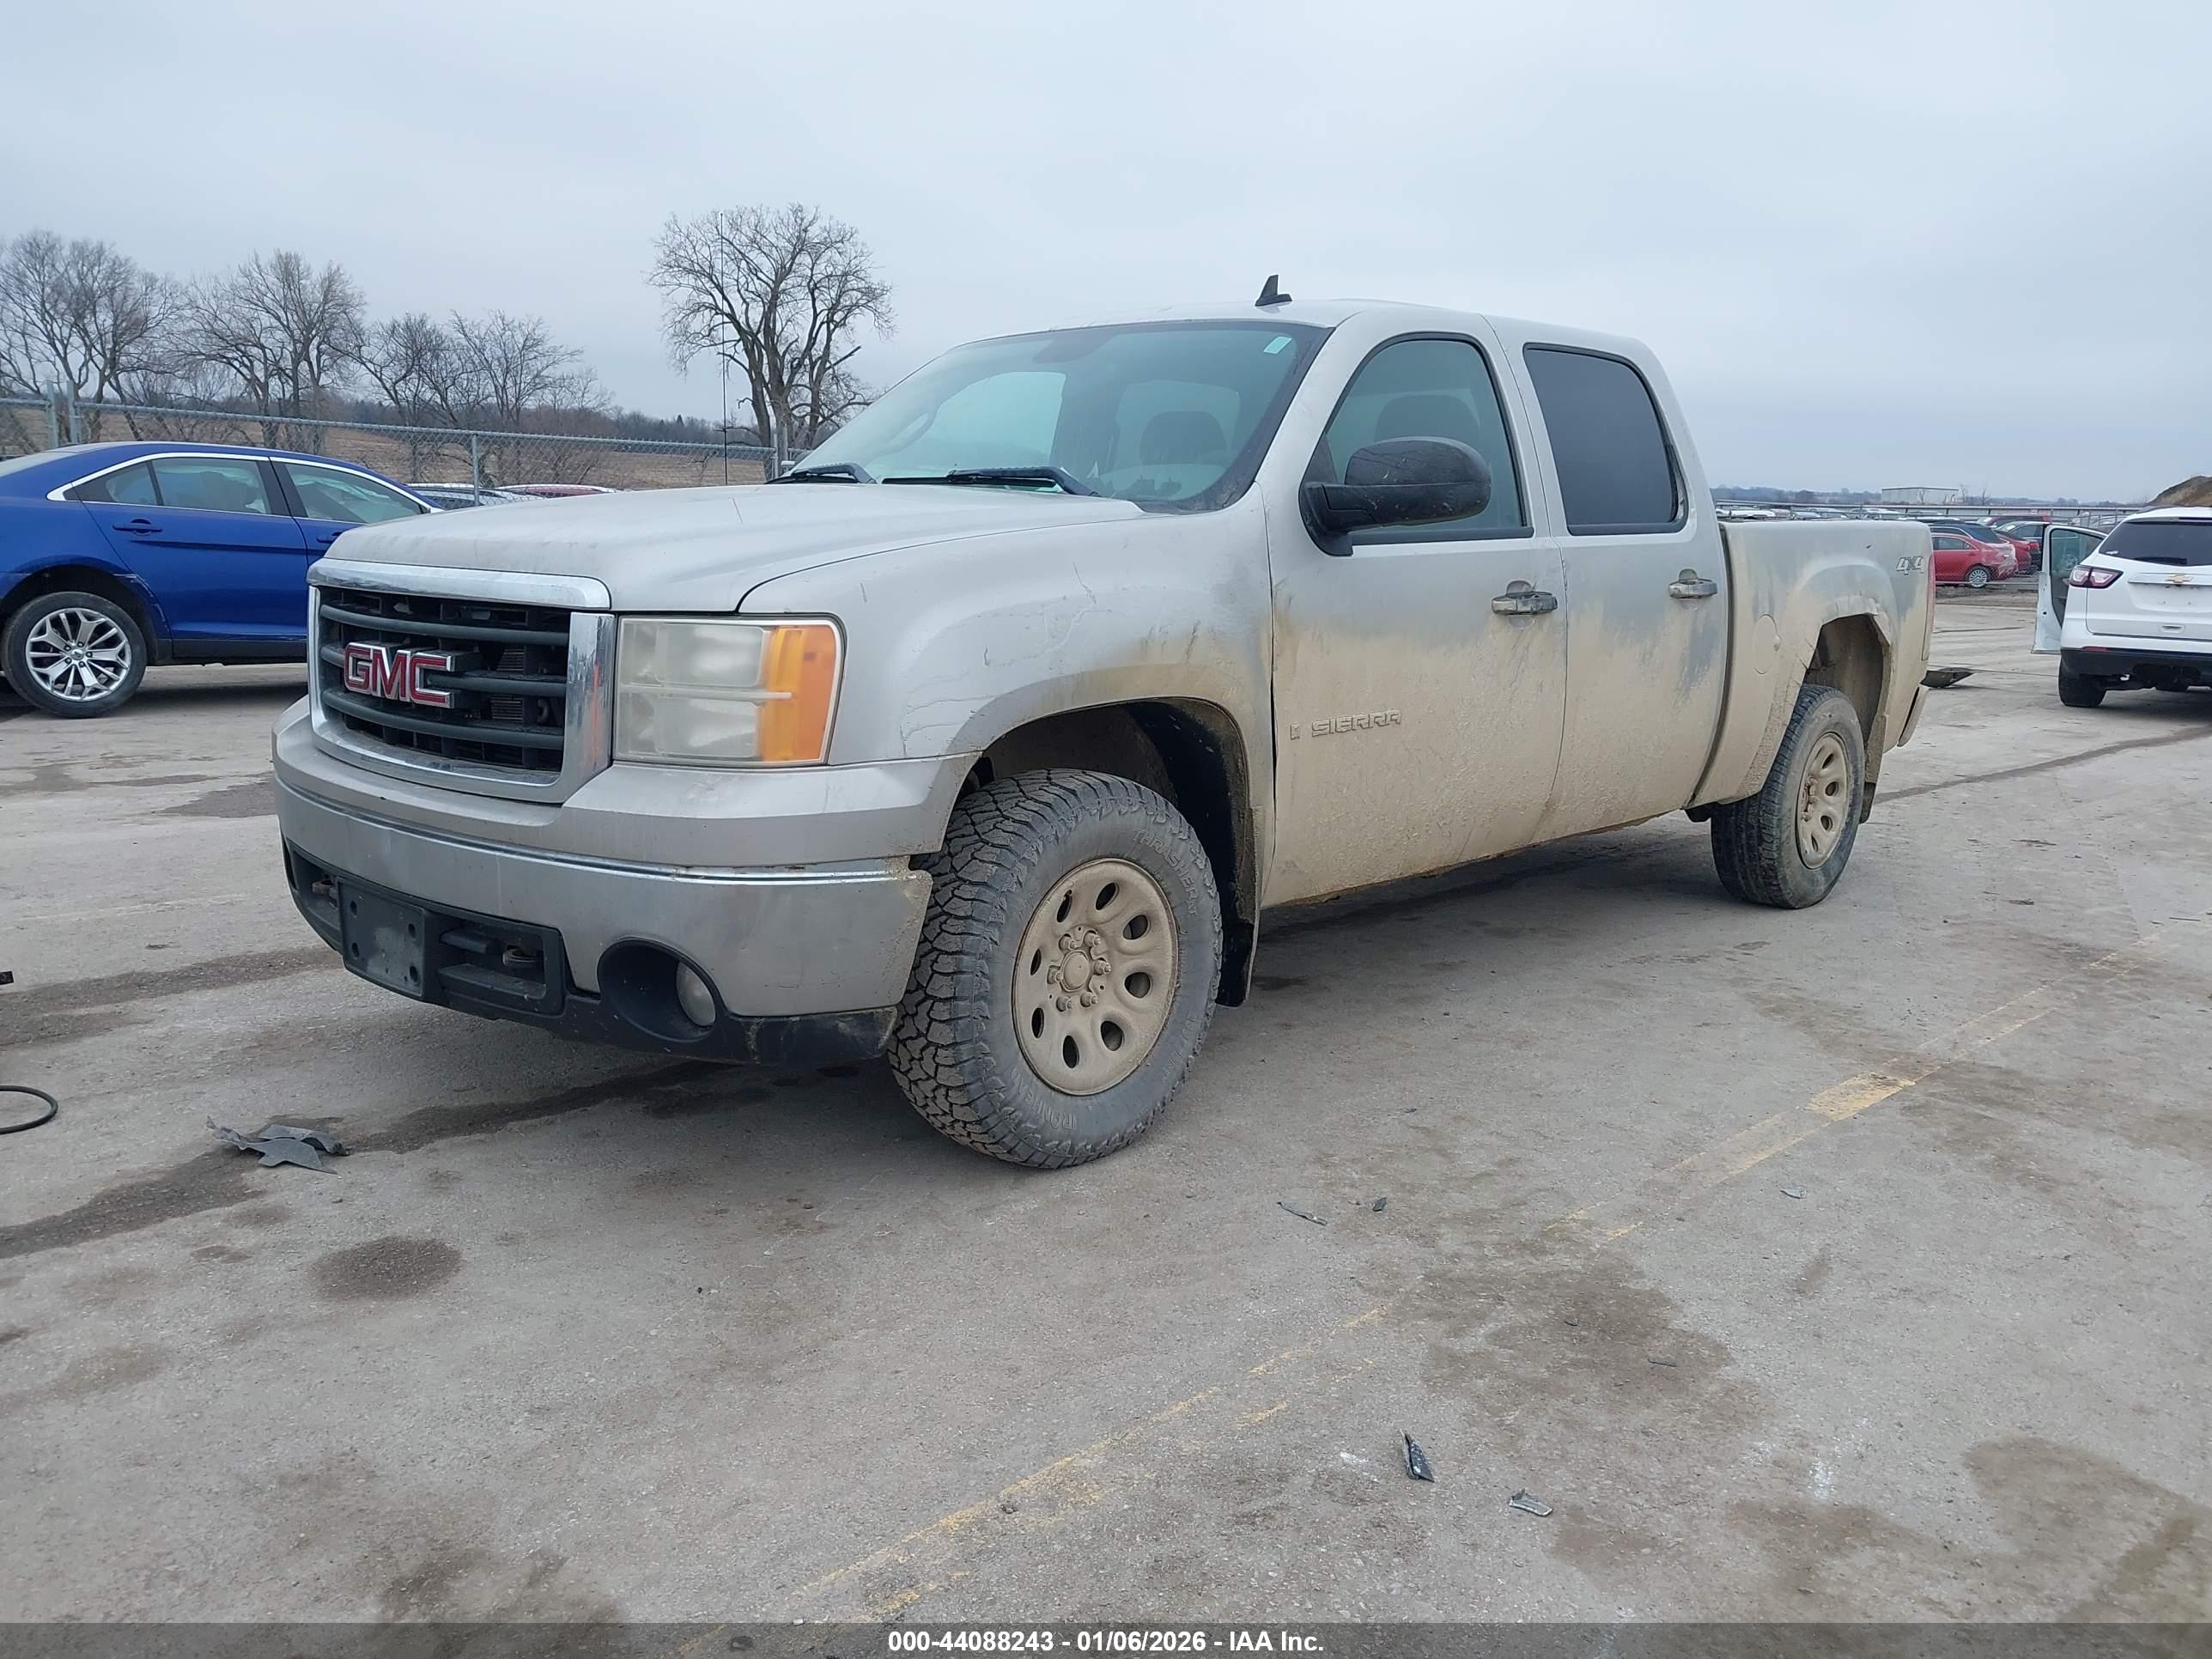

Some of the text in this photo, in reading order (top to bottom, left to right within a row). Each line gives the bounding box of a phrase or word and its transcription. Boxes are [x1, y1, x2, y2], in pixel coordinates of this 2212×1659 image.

[344, 641, 455, 708] GMC
[1311, 709, 1401, 738] SIERRA
[1133, 829, 1198, 901] THRASHER
